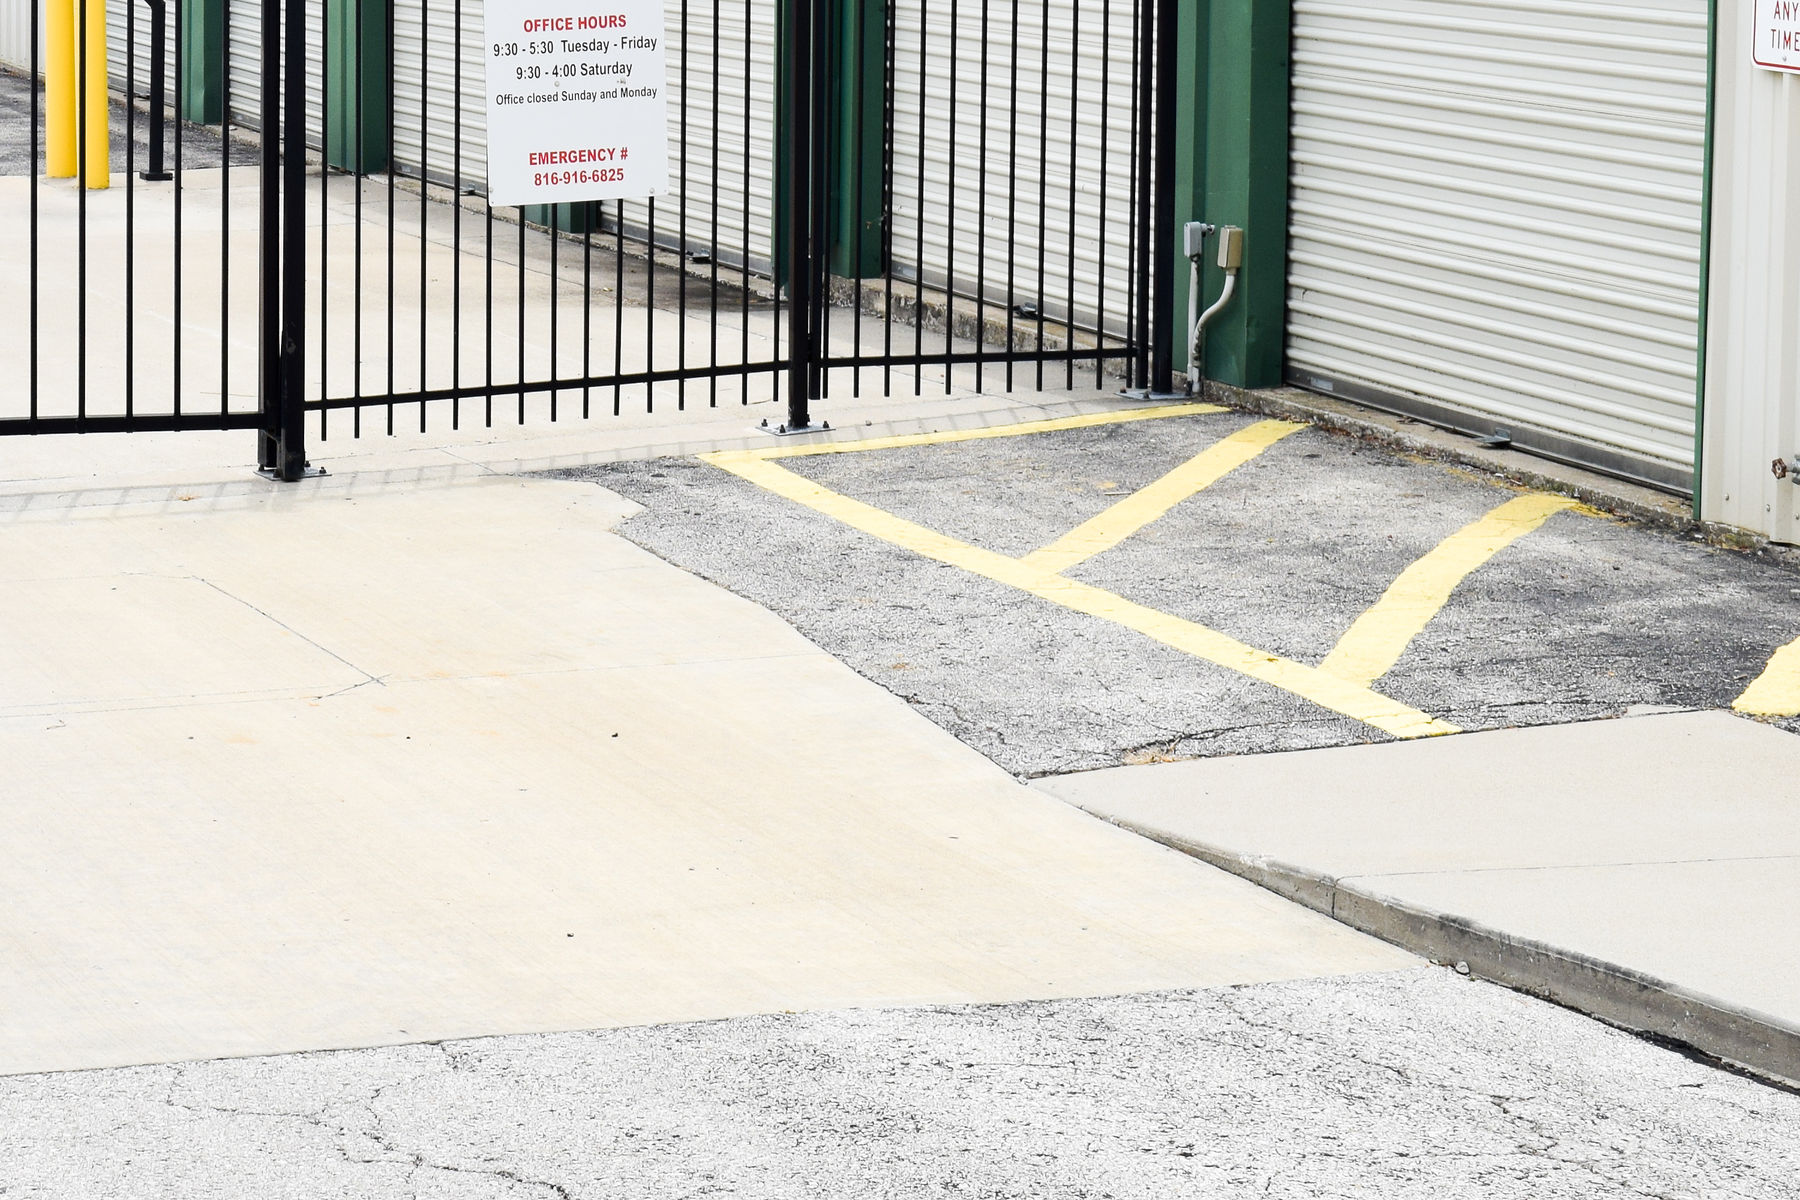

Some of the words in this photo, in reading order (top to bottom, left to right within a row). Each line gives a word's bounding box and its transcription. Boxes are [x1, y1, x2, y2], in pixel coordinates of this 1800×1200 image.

[1774, 0, 1799, 21] ANY
[524, 17, 573, 32] OFFICE
[578, 14, 627, 30] HOURS
[493, 42, 518, 57] 9:30
[530, 40, 554, 55] 5:30
[561, 39, 610, 54] Tuesday
[621, 36, 658, 51] Friday
[1771, 29, 1800, 51] TIME
[516, 66, 541, 80] 9:30
[552, 63, 577, 78] 4:00
[580, 61, 633, 77] Saturday
[496, 93, 525, 105] Office
[527, 91, 559, 104] closed
[561, 89, 597, 103] Sunday
[600, 88, 618, 99] and
[620, 86, 658, 99] Monday
[529, 147, 616, 166] EMERGENCY
[620, 146, 629, 160] #
[534, 167, 624, 187] 816-916-6825
